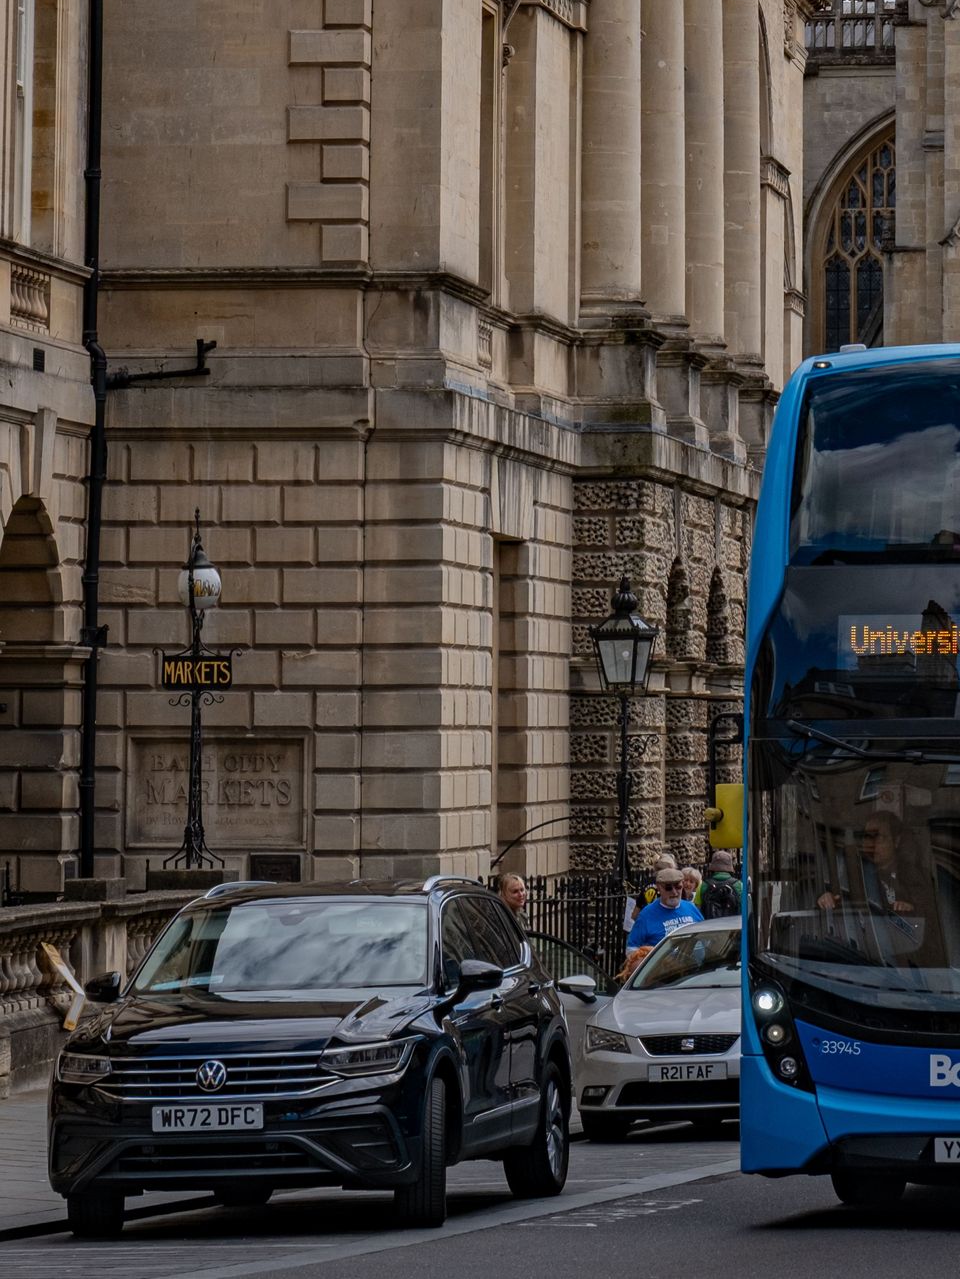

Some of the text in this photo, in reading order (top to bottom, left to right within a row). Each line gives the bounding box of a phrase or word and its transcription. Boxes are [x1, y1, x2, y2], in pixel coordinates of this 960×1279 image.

[164, 660, 231, 684] MARKETS
[145, 778, 292, 807] MARKETS
[821, 1040, 861, 1056] 33945
[661, 1065, 714, 1080] R21 FAF
[161, 1106, 255, 1128] WR72 DFC
